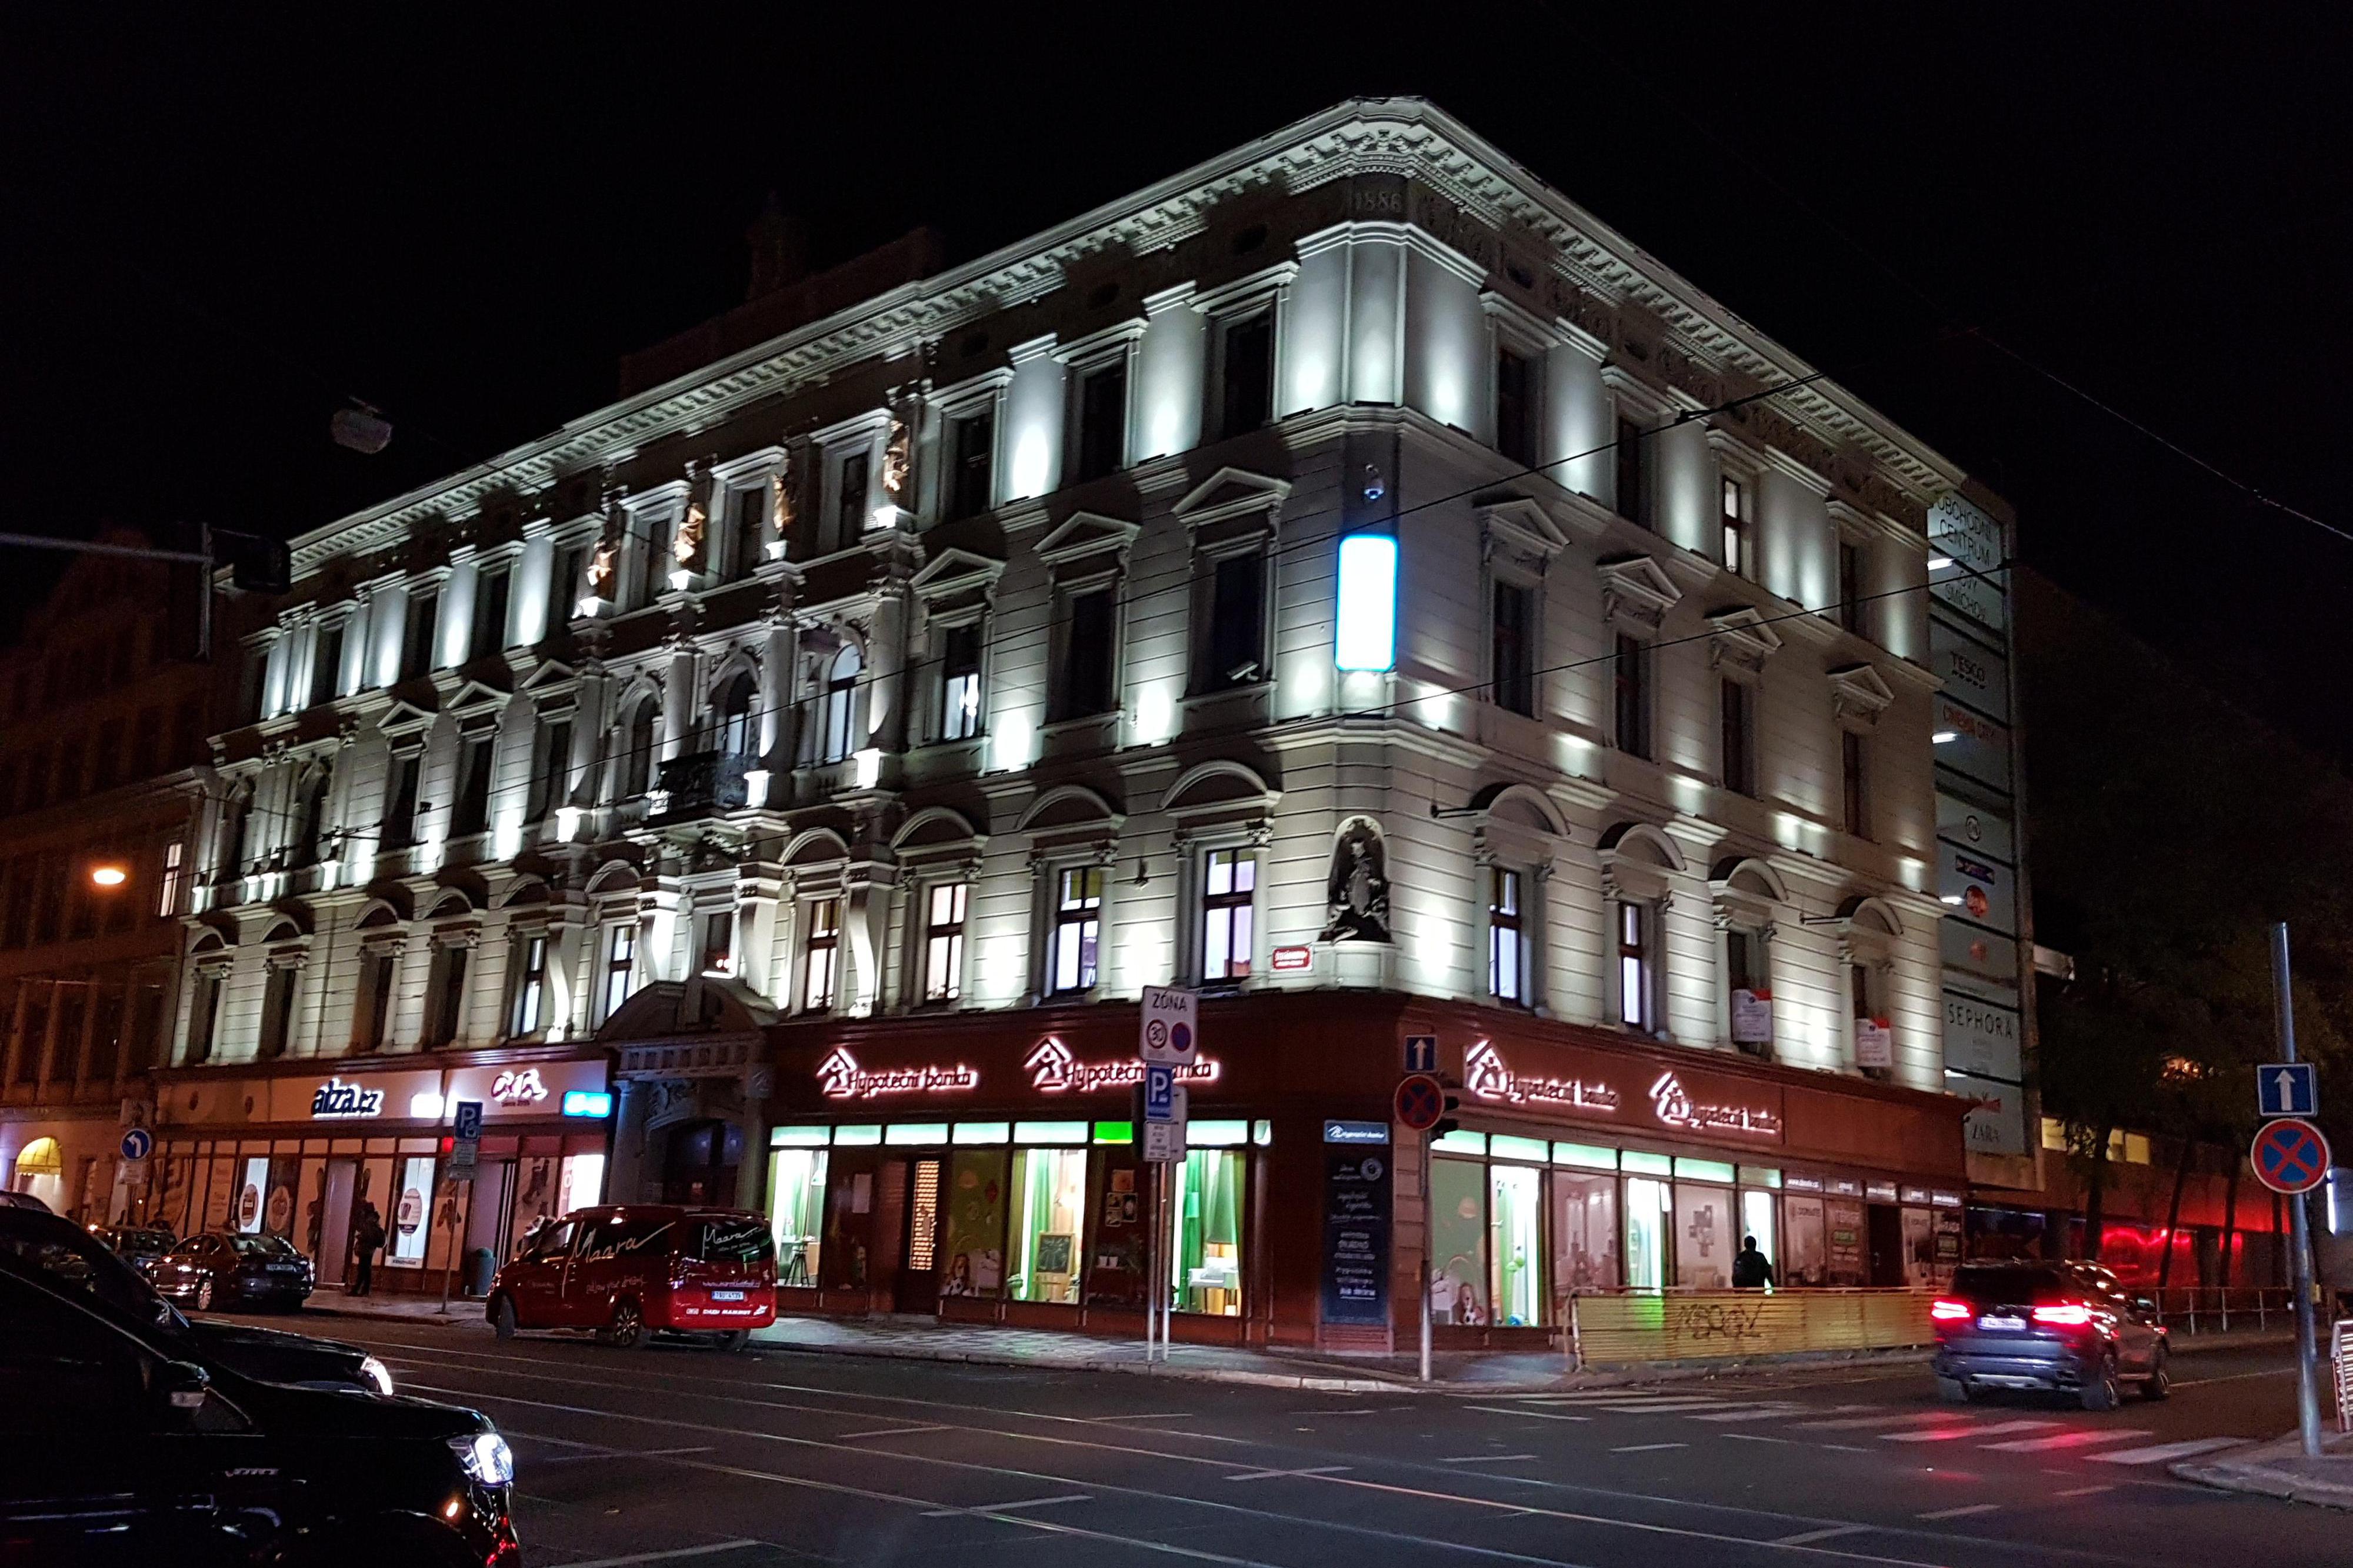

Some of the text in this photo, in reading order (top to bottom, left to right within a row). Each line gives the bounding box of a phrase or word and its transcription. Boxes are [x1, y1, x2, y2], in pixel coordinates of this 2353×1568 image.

[1939, 519, 1990, 566] CENTRUM
[1949, 650, 1986, 682] TESCO
[1948, 1003, 2013, 1040] SEPHORA
[848, 1067, 971, 1096] Hypoteční banka
[1064, 1058, 1147, 1089] Hypotečn
[1151, 1070, 1168, 1103] P
[312, 1080, 379, 1117] alza.cz
[460, 1107, 476, 1129] P
[561, 1216, 676, 1299] Maara
[701, 1225, 759, 1259] Maara
